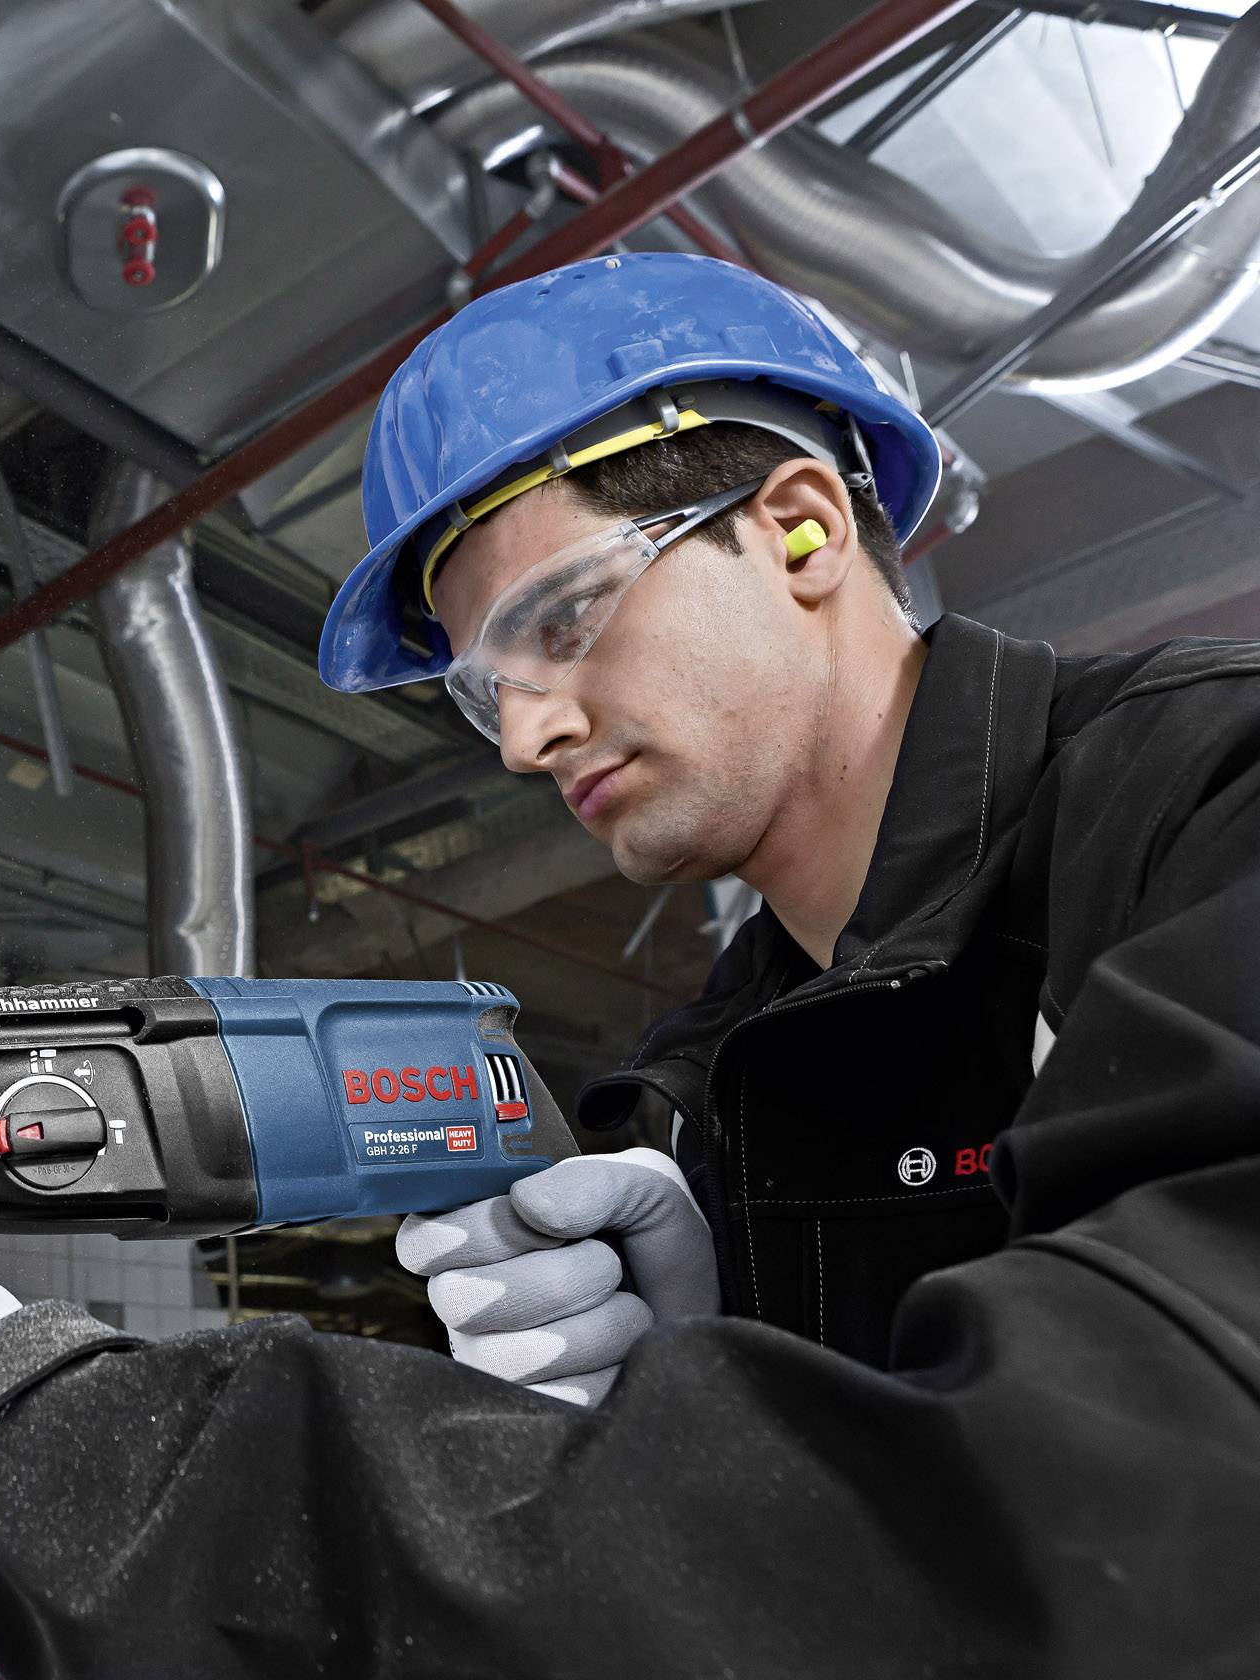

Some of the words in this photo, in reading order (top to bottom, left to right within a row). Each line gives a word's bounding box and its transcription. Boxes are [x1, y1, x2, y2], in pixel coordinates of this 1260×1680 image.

[342, 1065, 478, 1104] BOSCH
[364, 1127, 445, 1144] Professional
[449, 1130, 472, 1139] HEAVY
[453, 1139, 471, 1147] DUTY
[366, 1146, 387, 1156] GBH
[390, 1144, 410, 1154] 2-26
[412, 1144, 418, 1153] F
